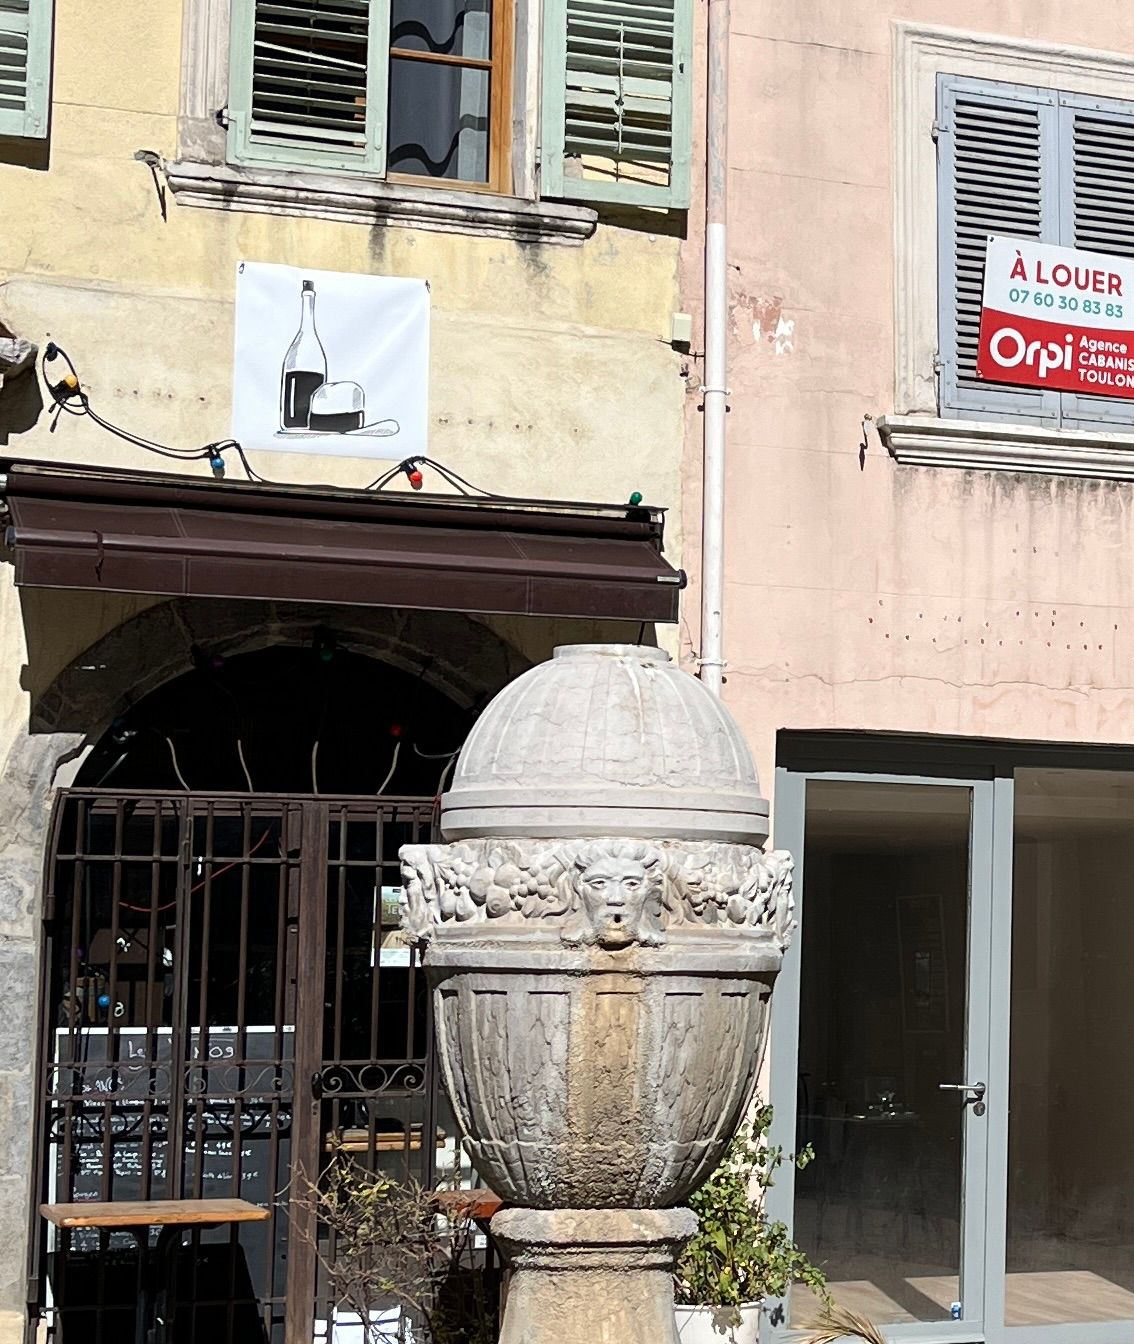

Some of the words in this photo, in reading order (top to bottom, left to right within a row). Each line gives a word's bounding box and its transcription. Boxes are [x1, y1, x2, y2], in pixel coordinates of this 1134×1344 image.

[1009, 250, 1028, 282] À
[1036, 260, 1123, 296] LOUER
[1009, 288, 1029, 304] 07
[1033, 292, 1054, 308] 60
[1058, 295, 1079, 311] 30
[1082, 299, 1101, 315] 83
[1106, 303, 1123, 318] 83
[989, 327, 1074, 378] Orpi
[1079, 335, 1128, 354] Agence
